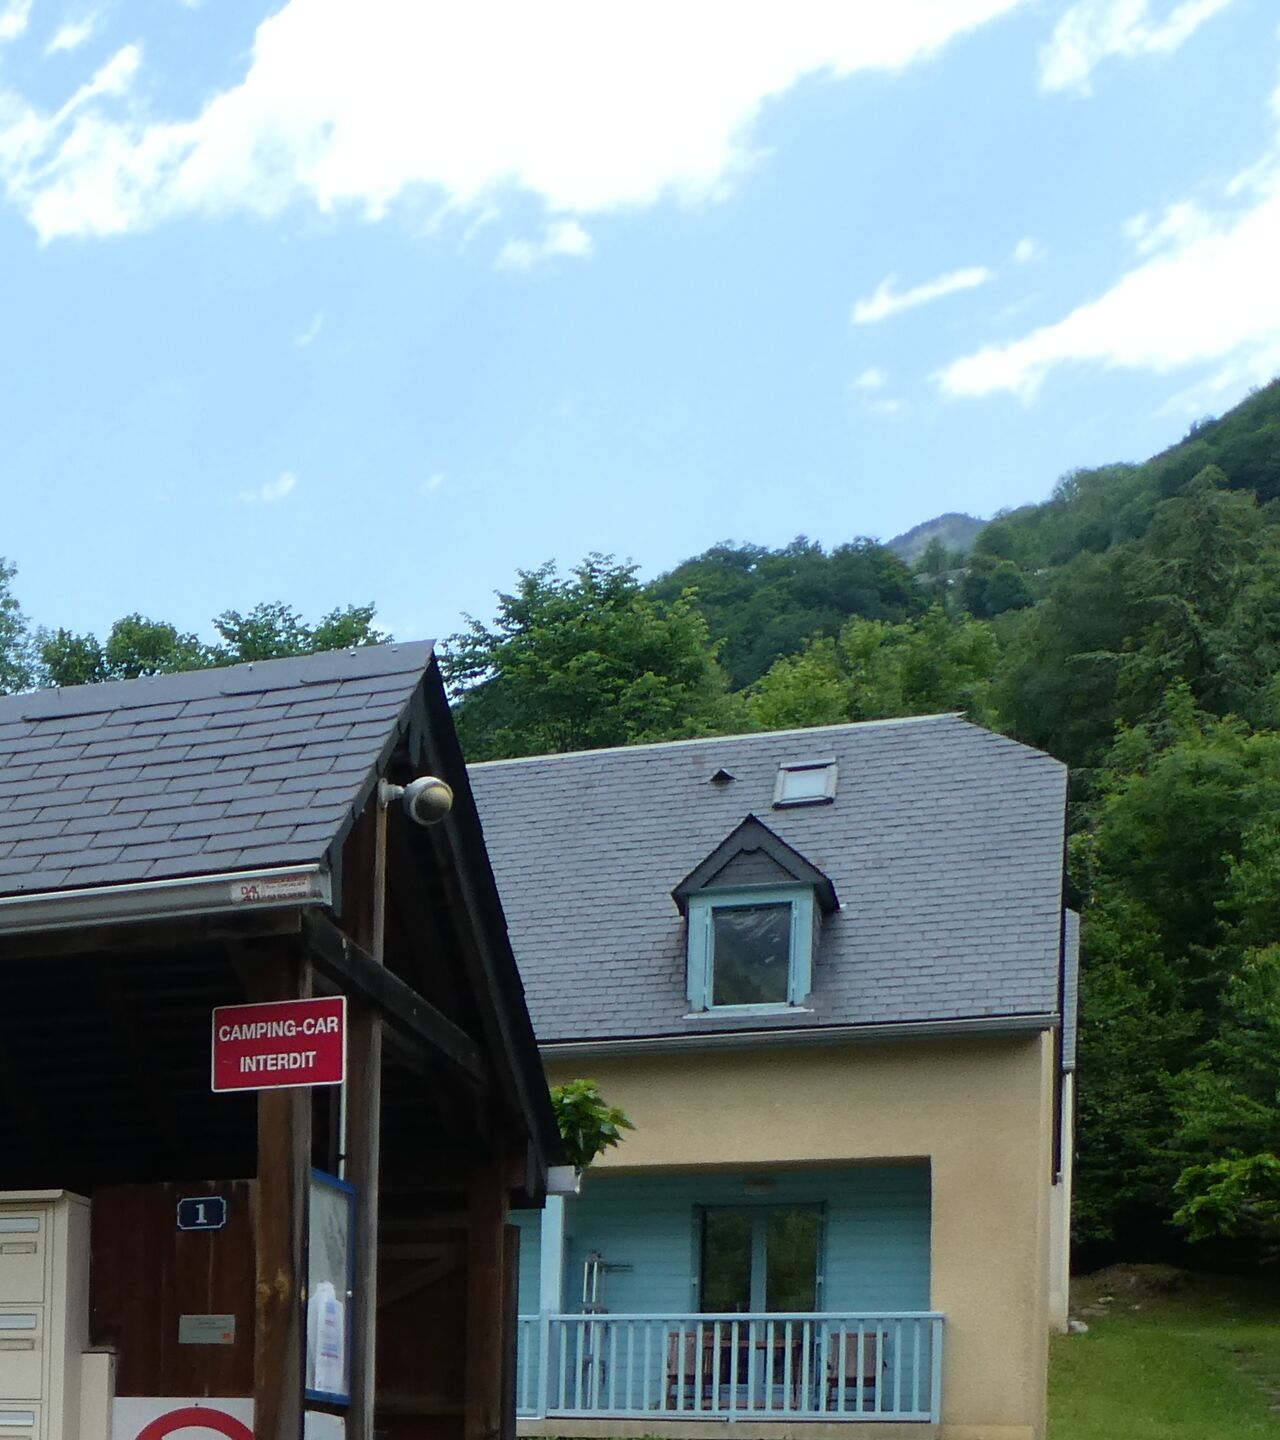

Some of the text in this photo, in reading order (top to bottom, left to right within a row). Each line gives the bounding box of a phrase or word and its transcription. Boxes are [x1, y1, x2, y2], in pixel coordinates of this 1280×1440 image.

[219, 1016, 339, 1041] CAMPING-CAR
[240, 1051, 317, 1073] INTERDIT
[195, 1203, 208, 1224] 1
